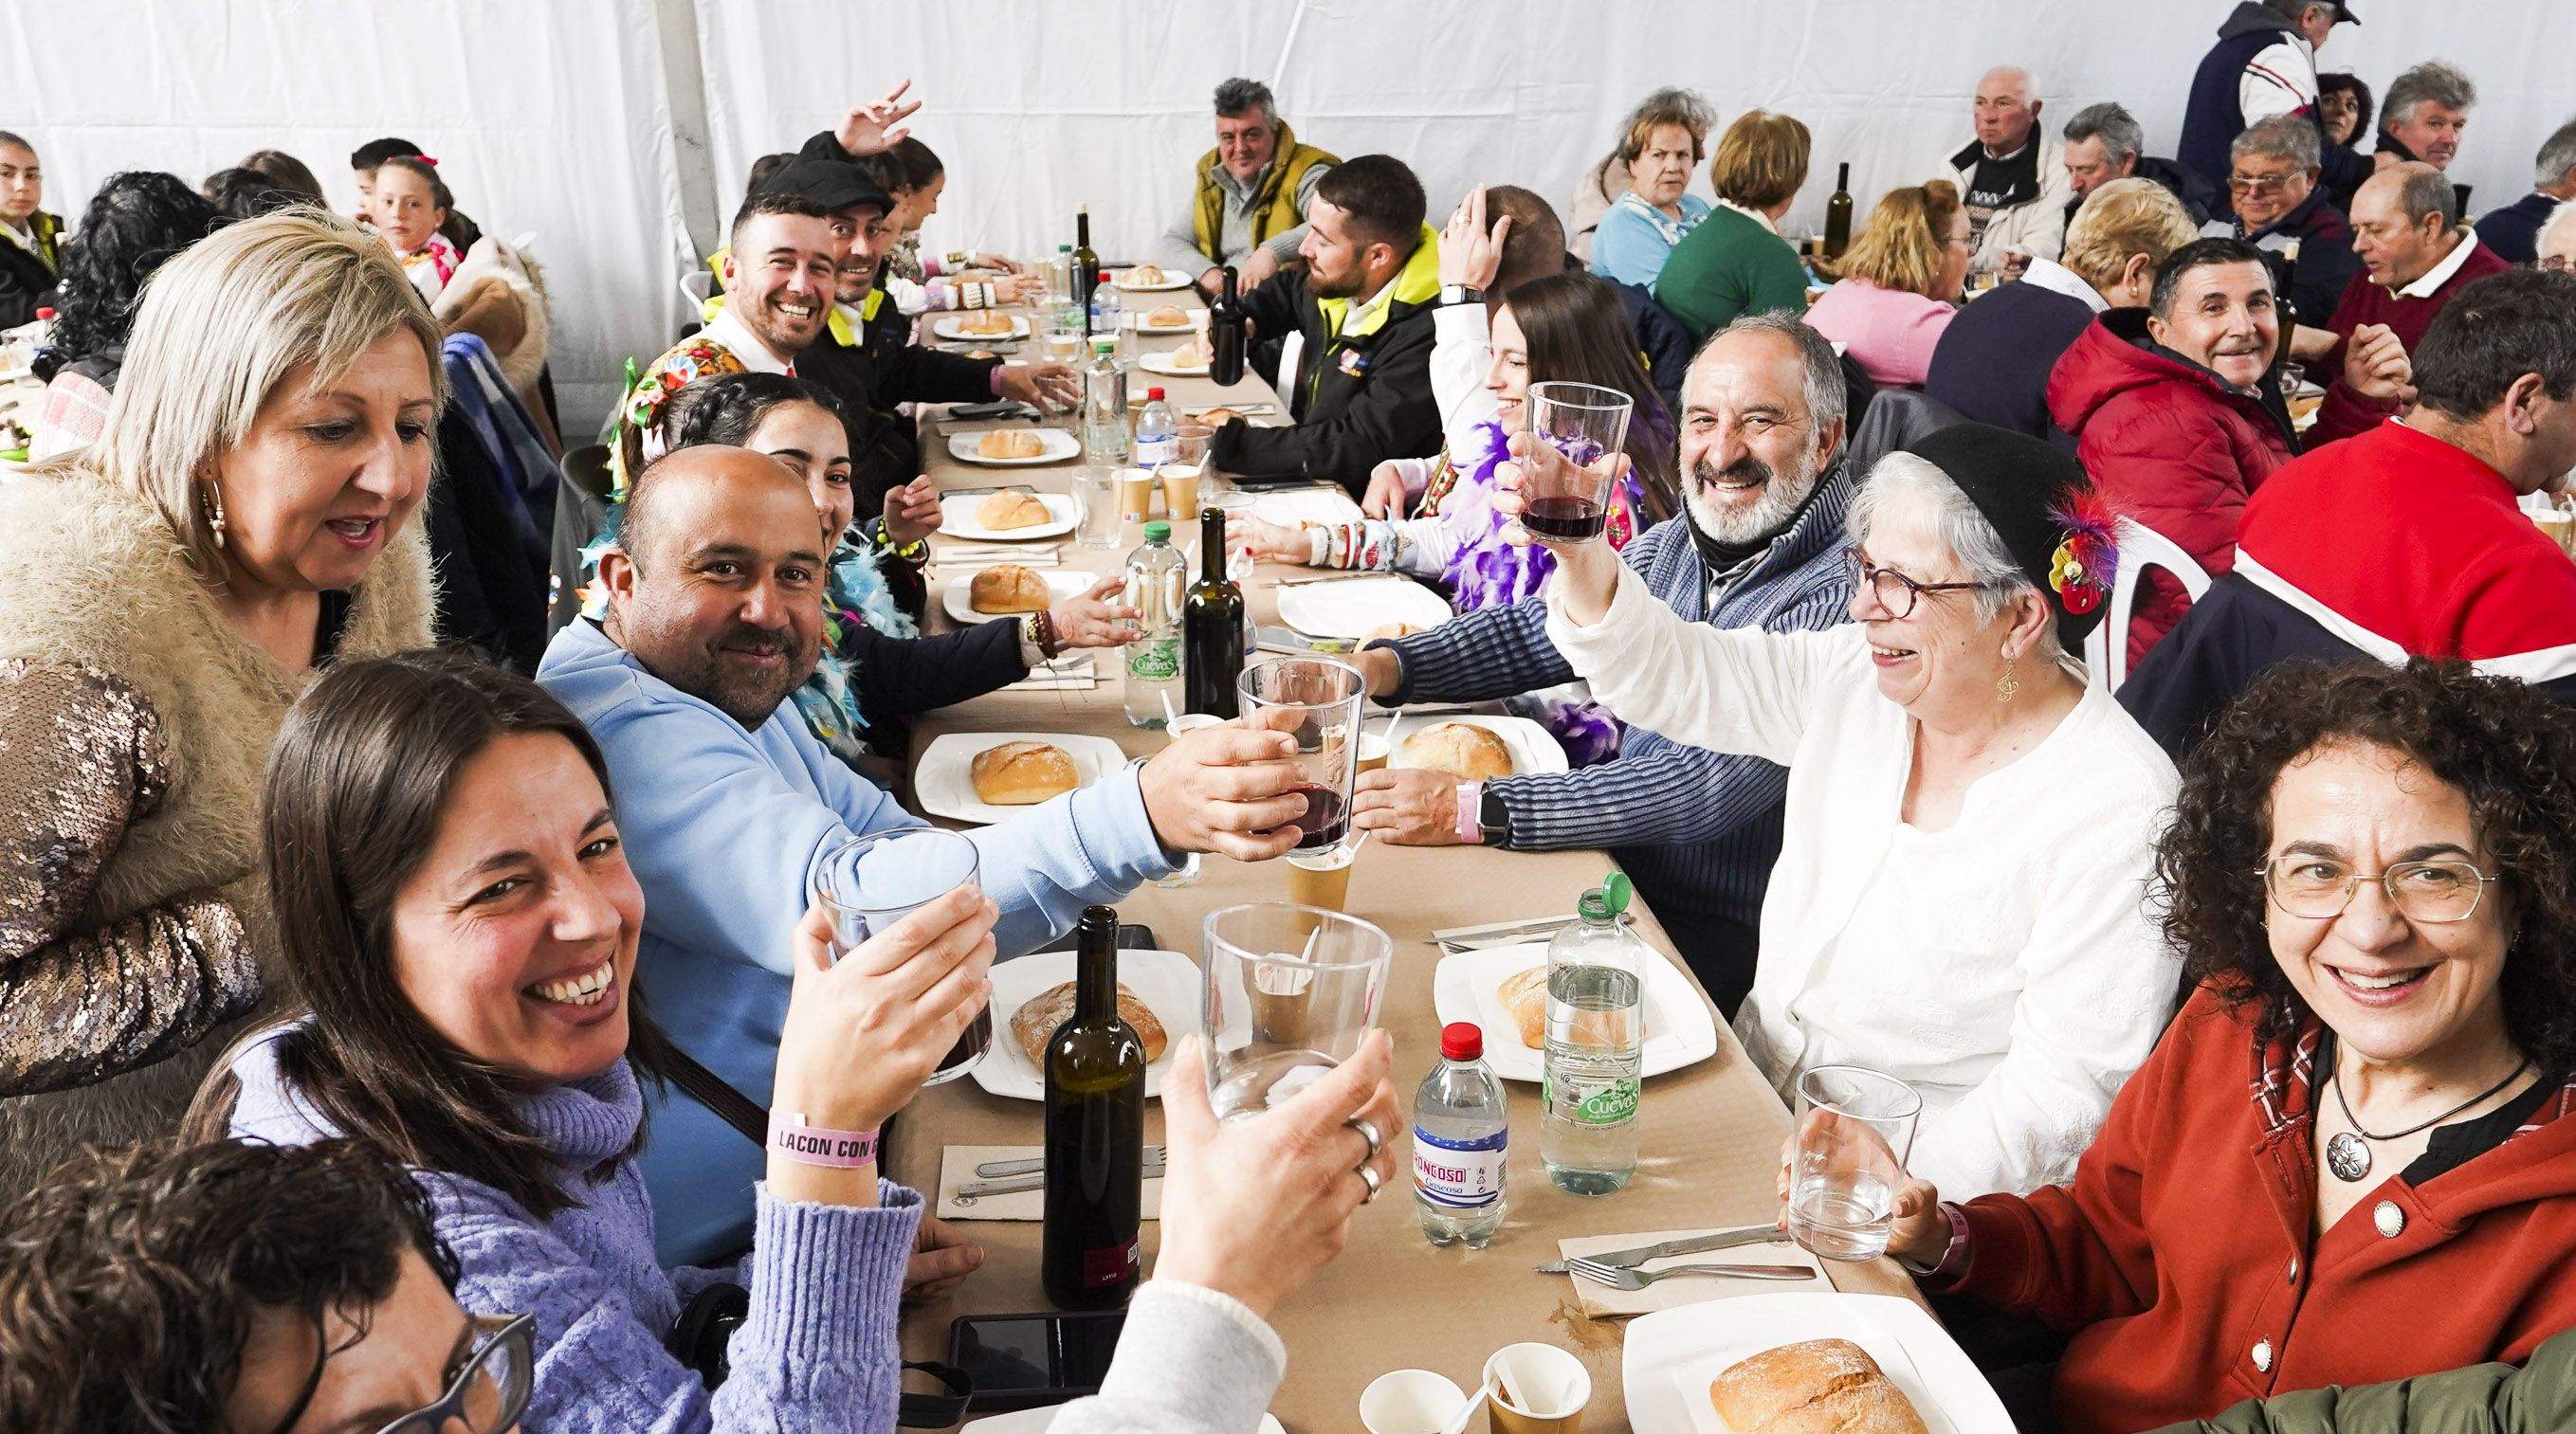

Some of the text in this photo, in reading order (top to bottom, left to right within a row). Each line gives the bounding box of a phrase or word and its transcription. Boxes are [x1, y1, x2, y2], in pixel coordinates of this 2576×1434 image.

[778, 1131, 832, 1155] LACON
[837, 1139, 871, 1157] CON
[1425, 1177, 1463, 1194] Gaseosa
